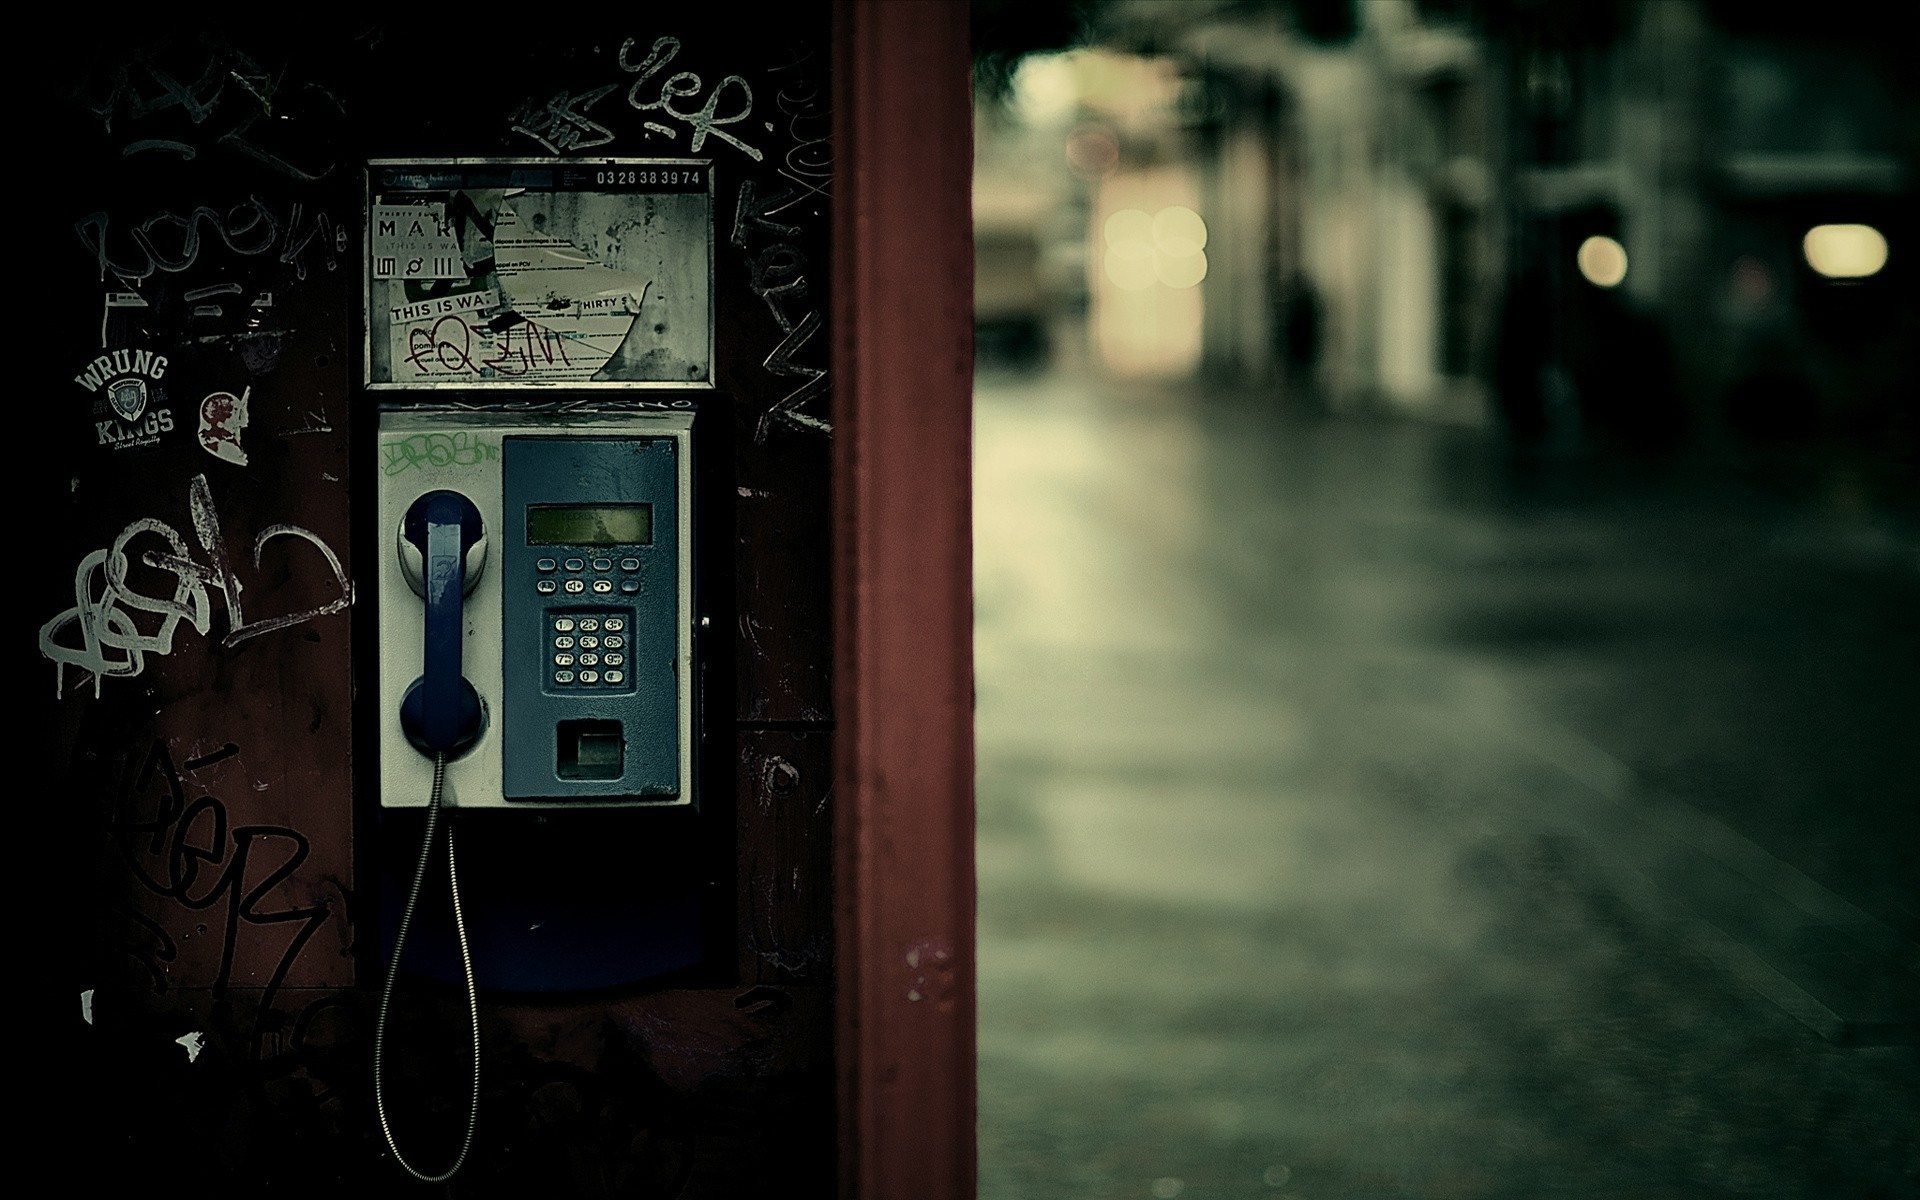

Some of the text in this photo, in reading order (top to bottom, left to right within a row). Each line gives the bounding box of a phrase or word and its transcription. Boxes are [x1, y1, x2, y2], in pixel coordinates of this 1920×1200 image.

[596, 172, 700, 185] 0328383974
[392, 293, 491, 320] THIS IS WA
[581, 297, 621, 309] HIRTY
[74, 349, 169, 392] WRUNG
[95, 408, 174, 445] KINGS
